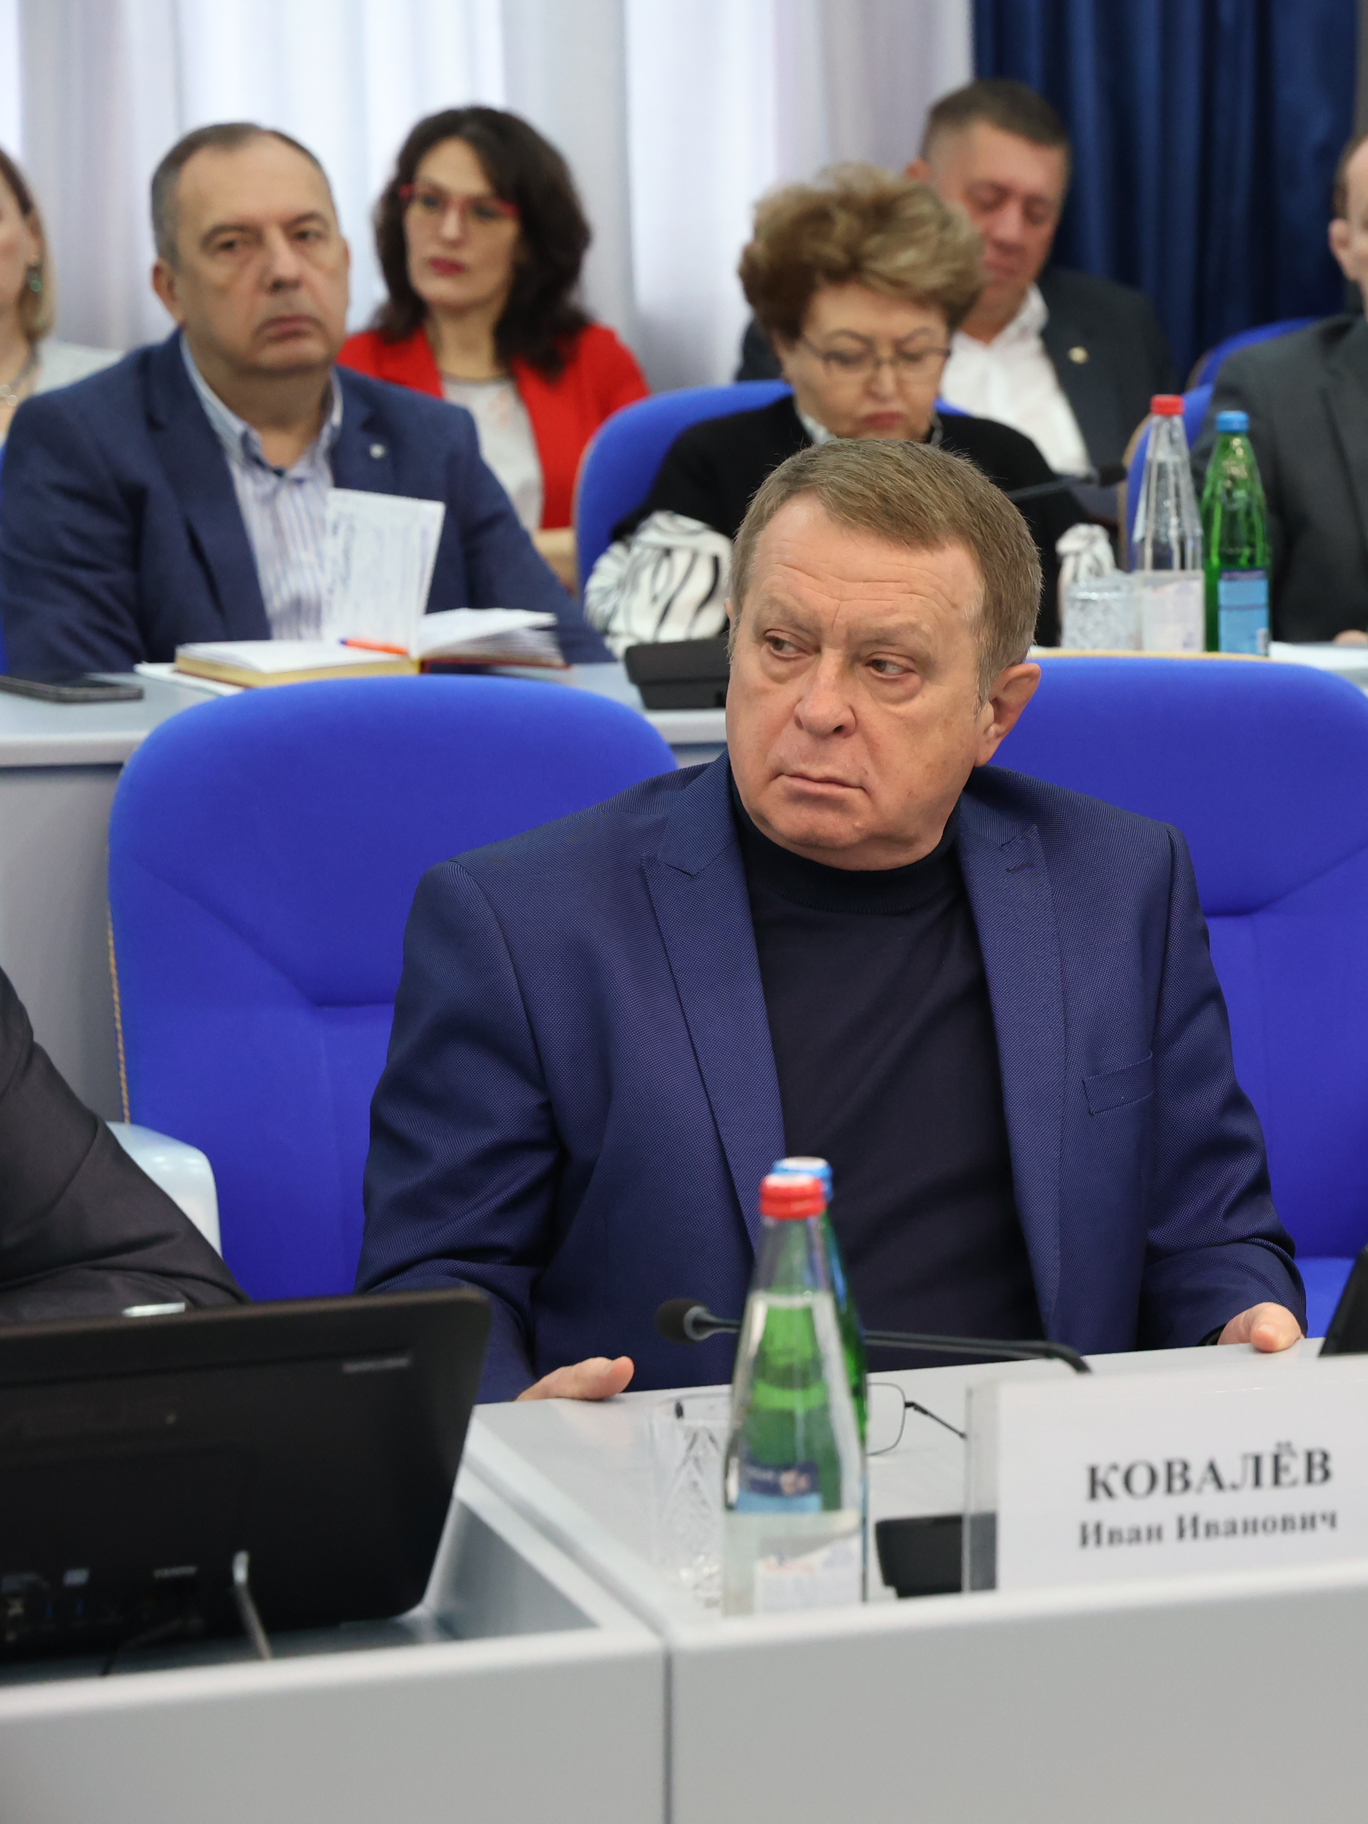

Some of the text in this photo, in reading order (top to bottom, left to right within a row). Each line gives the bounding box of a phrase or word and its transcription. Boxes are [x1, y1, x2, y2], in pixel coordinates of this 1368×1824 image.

[1086, 1440, 1332, 1502] КОВАЛЁВ
[1079, 1509, 1338, 1549] Иван Иванович
